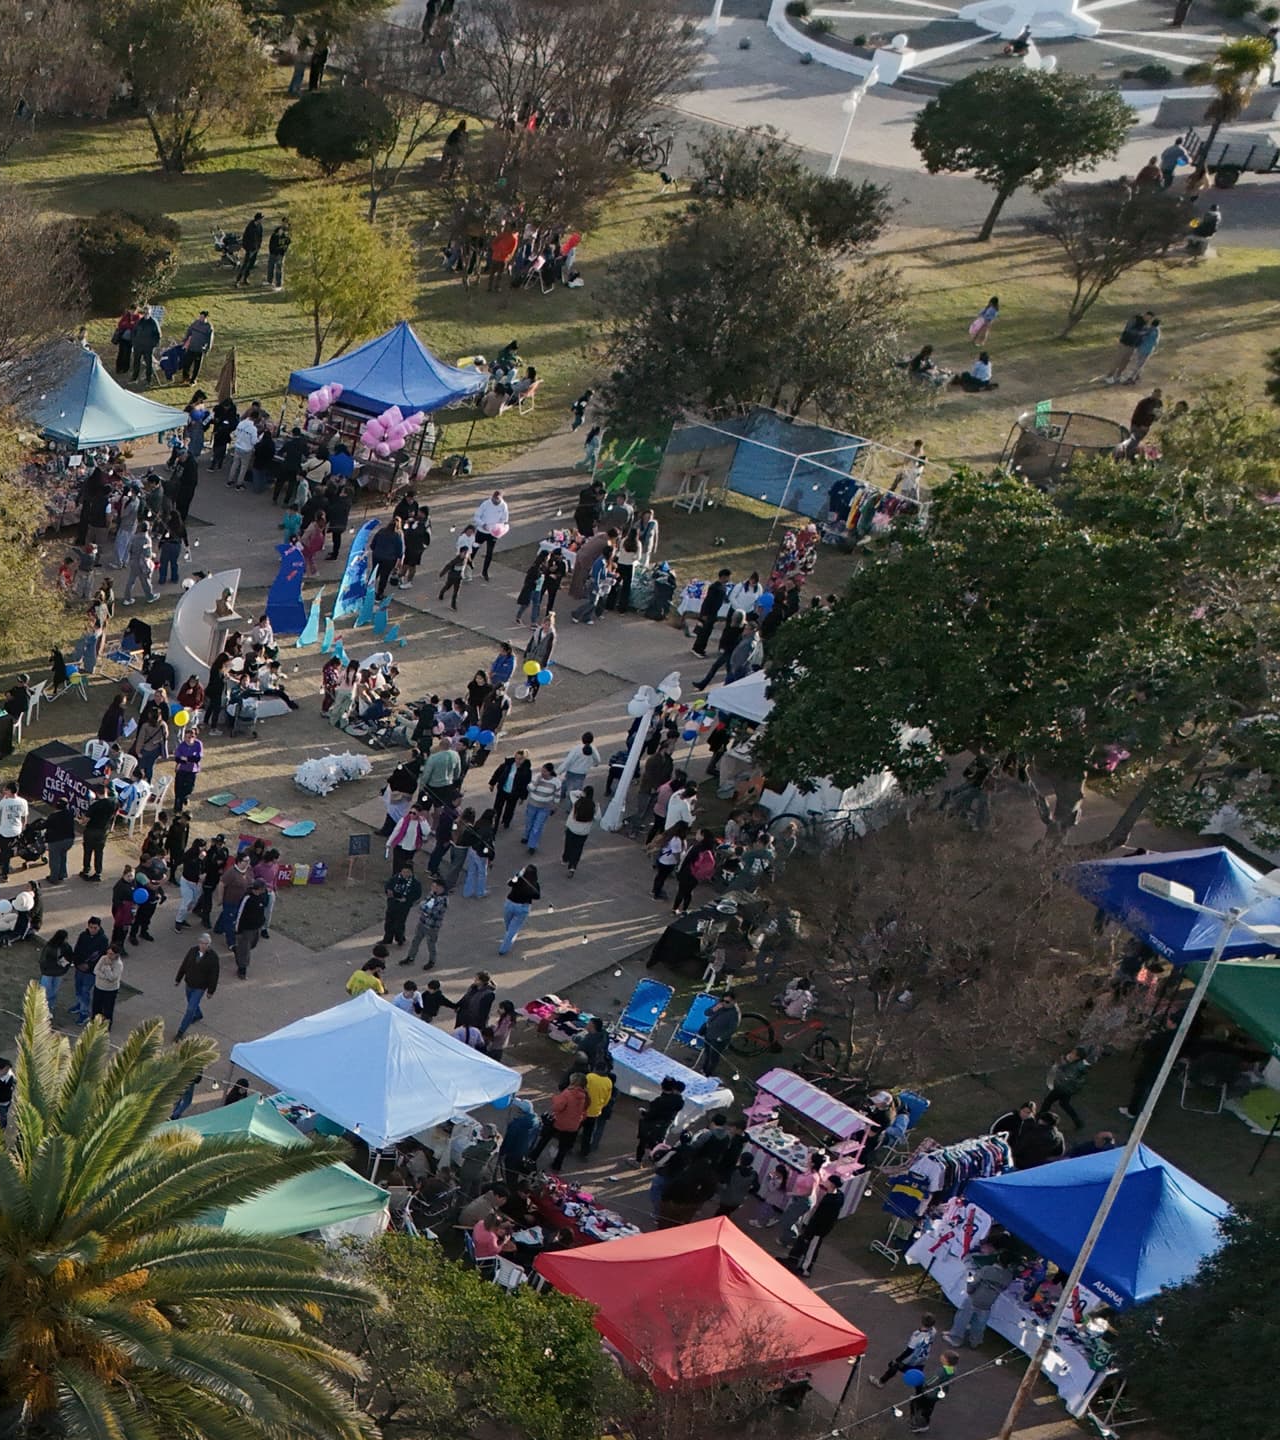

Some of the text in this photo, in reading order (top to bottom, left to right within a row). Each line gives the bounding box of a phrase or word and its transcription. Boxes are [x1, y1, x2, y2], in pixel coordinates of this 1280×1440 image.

[45, 776, 66, 793] CREE
[42, 788, 55, 803] SU
[1093, 1280, 1124, 1307] ALPINA
